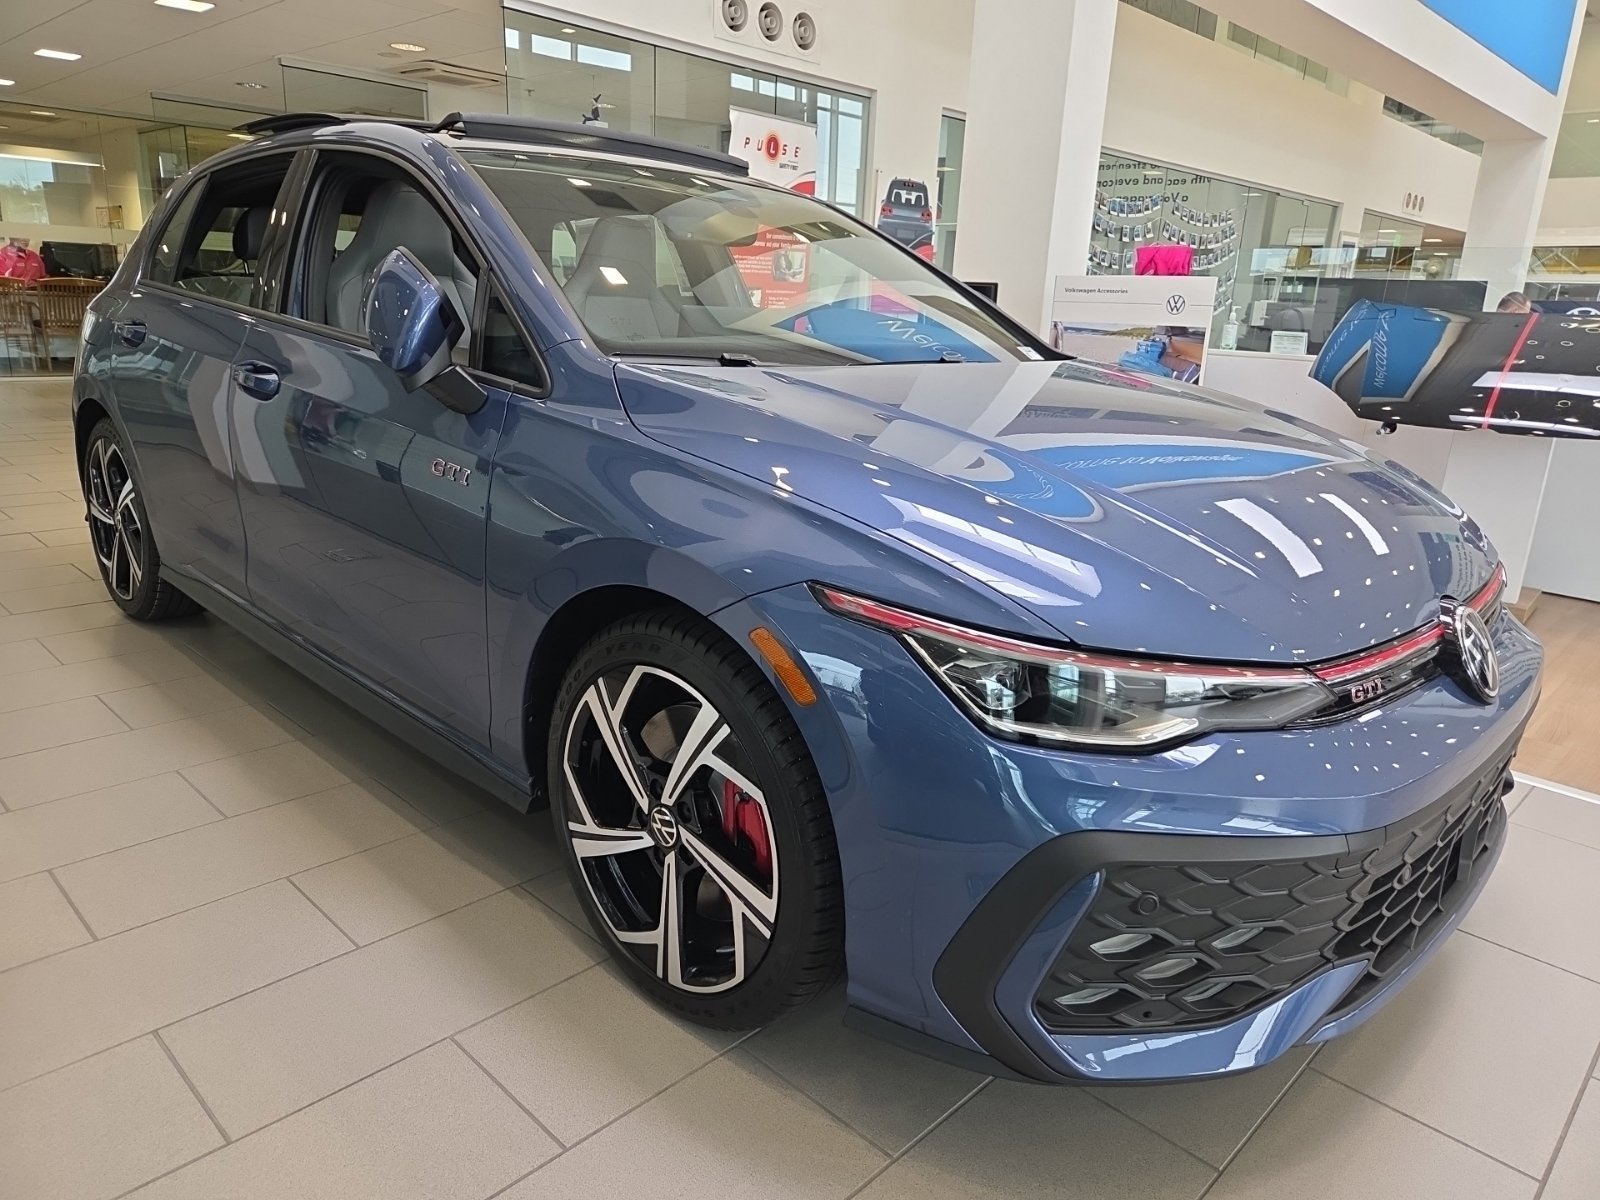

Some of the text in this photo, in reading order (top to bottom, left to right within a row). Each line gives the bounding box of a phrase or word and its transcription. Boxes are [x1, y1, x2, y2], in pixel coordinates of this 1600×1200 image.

[744, 137, 801, 158] PULSE
[1064, 287, 1097, 295] Volkswagen
[432, 457, 471, 486] GTI
[1351, 677, 1386, 703] GTI
